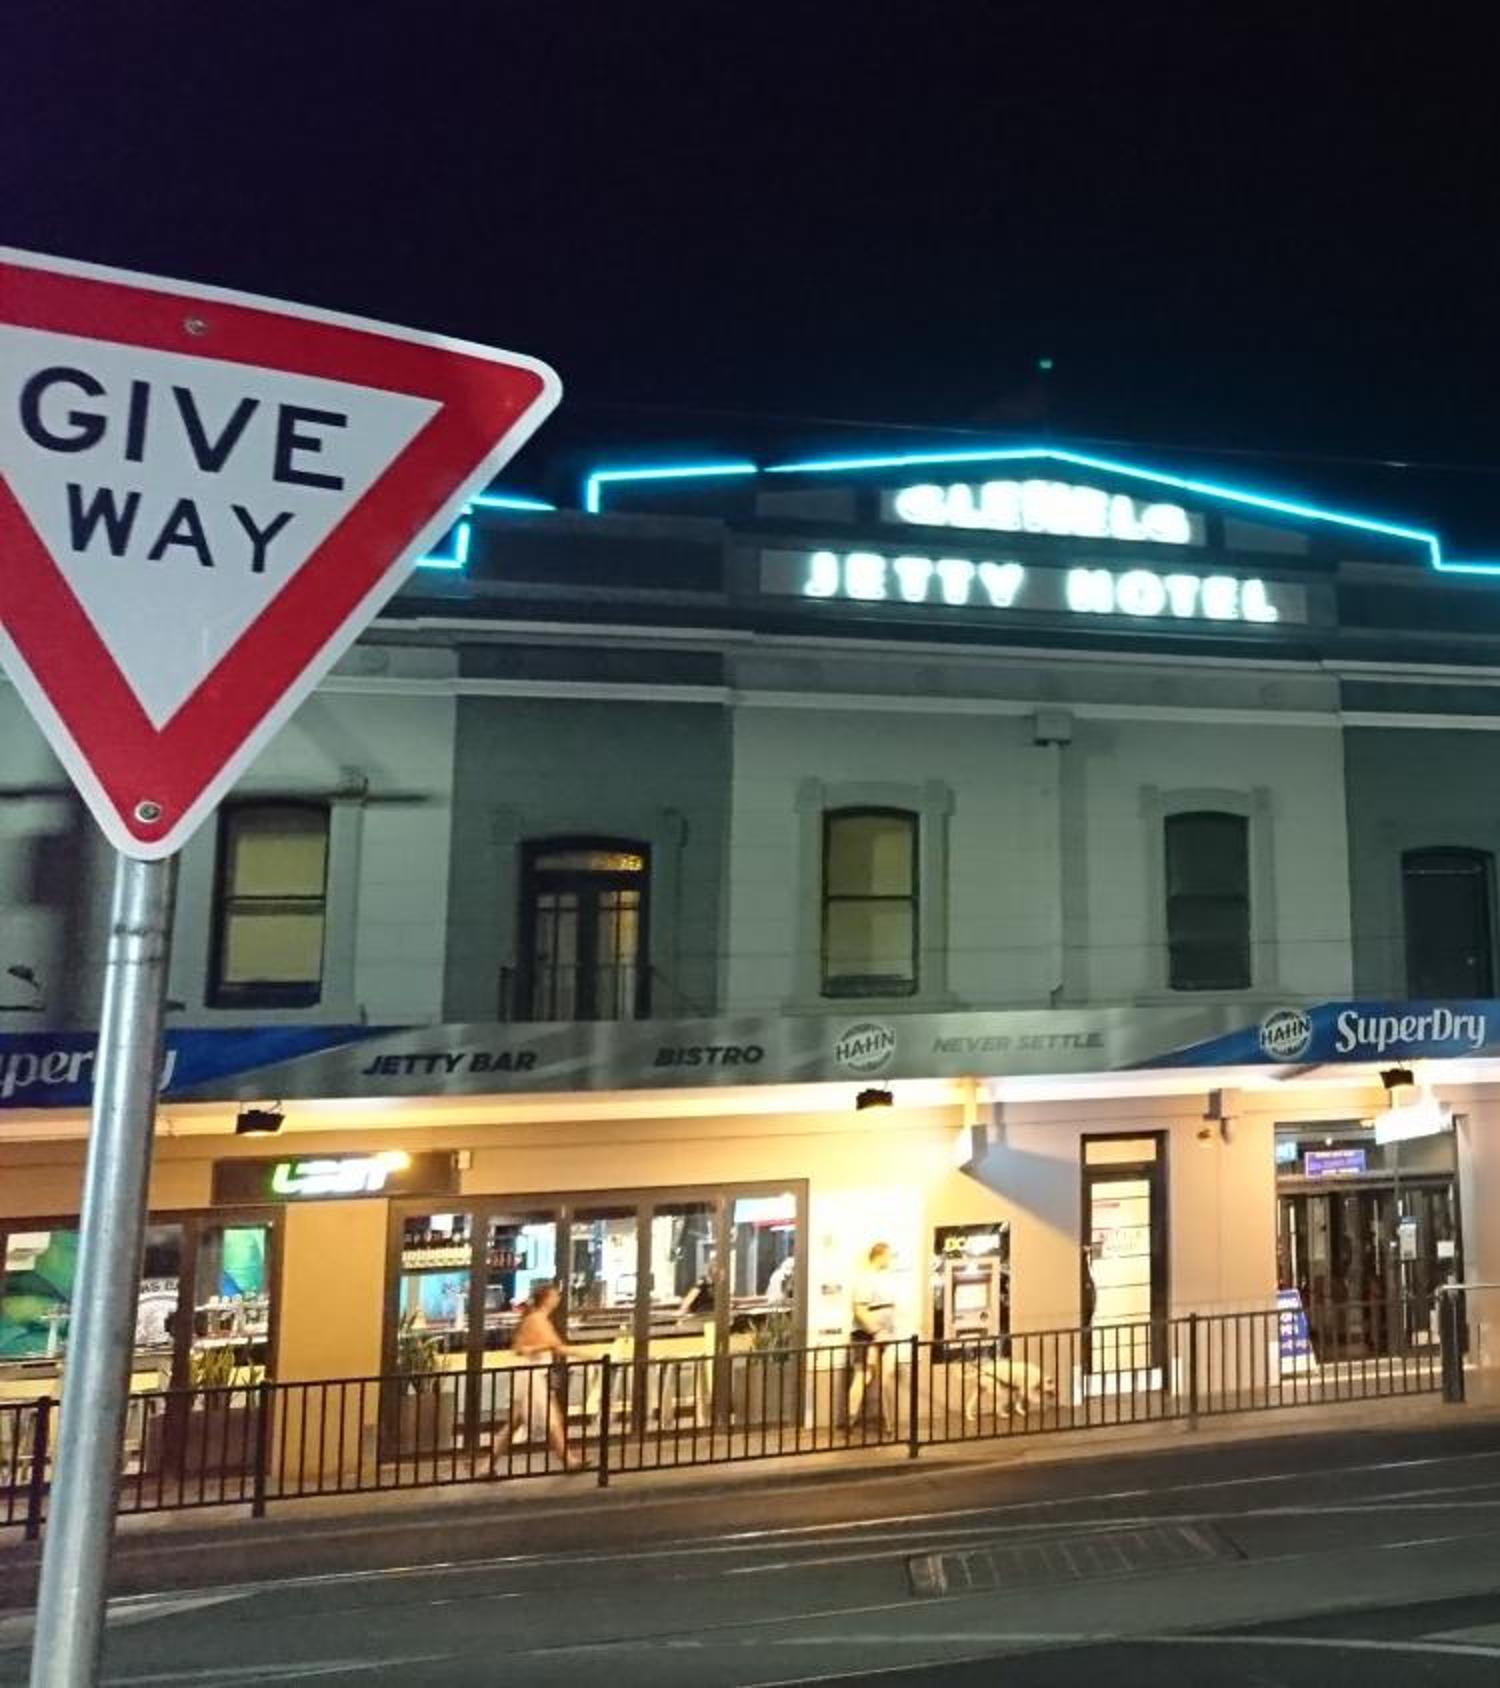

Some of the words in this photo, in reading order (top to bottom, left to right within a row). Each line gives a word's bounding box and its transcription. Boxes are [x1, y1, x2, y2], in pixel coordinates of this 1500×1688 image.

[19, 366, 348, 491] GIVE
[66, 482, 295, 573] WAY
[804, 550, 1024, 607] JETTY
[1066, 568, 1278, 622] HOTEL
[836, 1030, 896, 1061] HAHN
[1261, 1016, 1311, 1046] HAHN
[1335, 1008, 1486, 1053] SuperDry
[363, 1051, 464, 1076] JETTY
[469, 1050, 538, 1074] BAR
[654, 1045, 764, 1068] BISTRO
